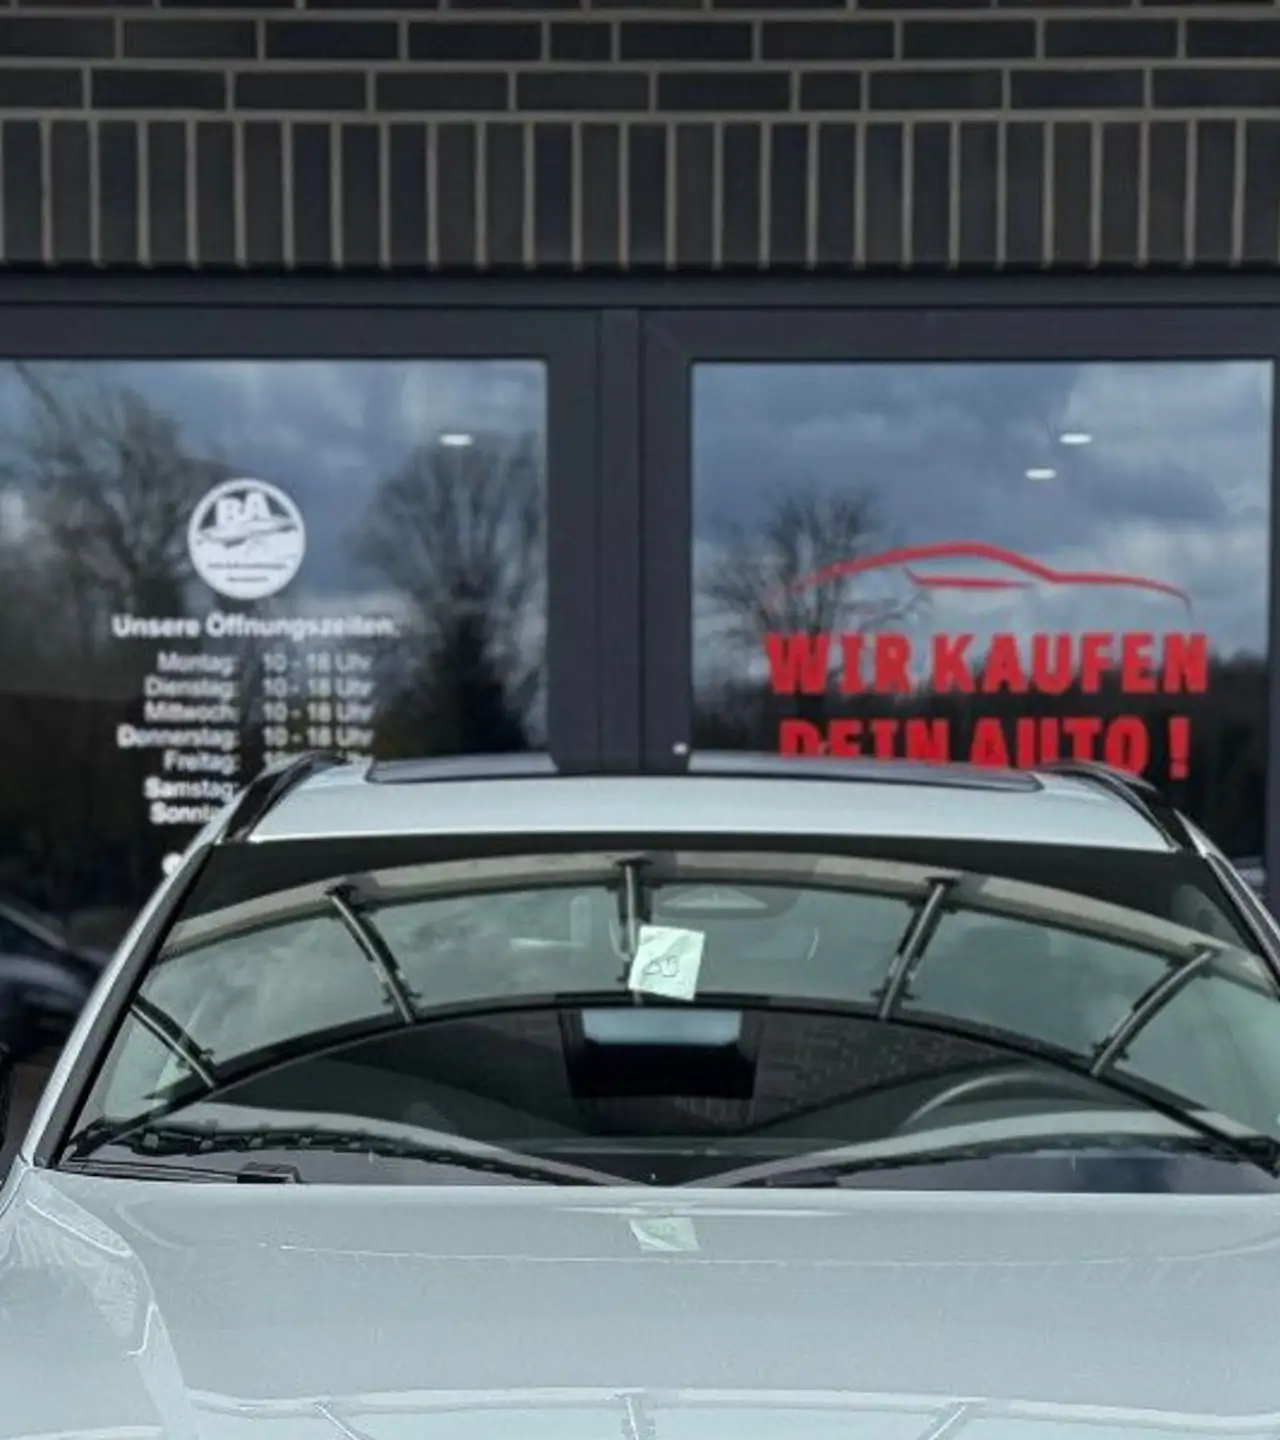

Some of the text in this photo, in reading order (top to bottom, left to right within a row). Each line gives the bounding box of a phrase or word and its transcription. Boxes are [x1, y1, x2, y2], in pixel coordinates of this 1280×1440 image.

[112, 614, 200, 638] Unsere
[336, 652, 373, 673] Uhr
[764, 632, 1208, 694] WIR KAUFEN
[336, 677, 373, 698] Uhr
[336, 701, 373, 722] Uhr
[336, 725, 373, 746] Uhr
